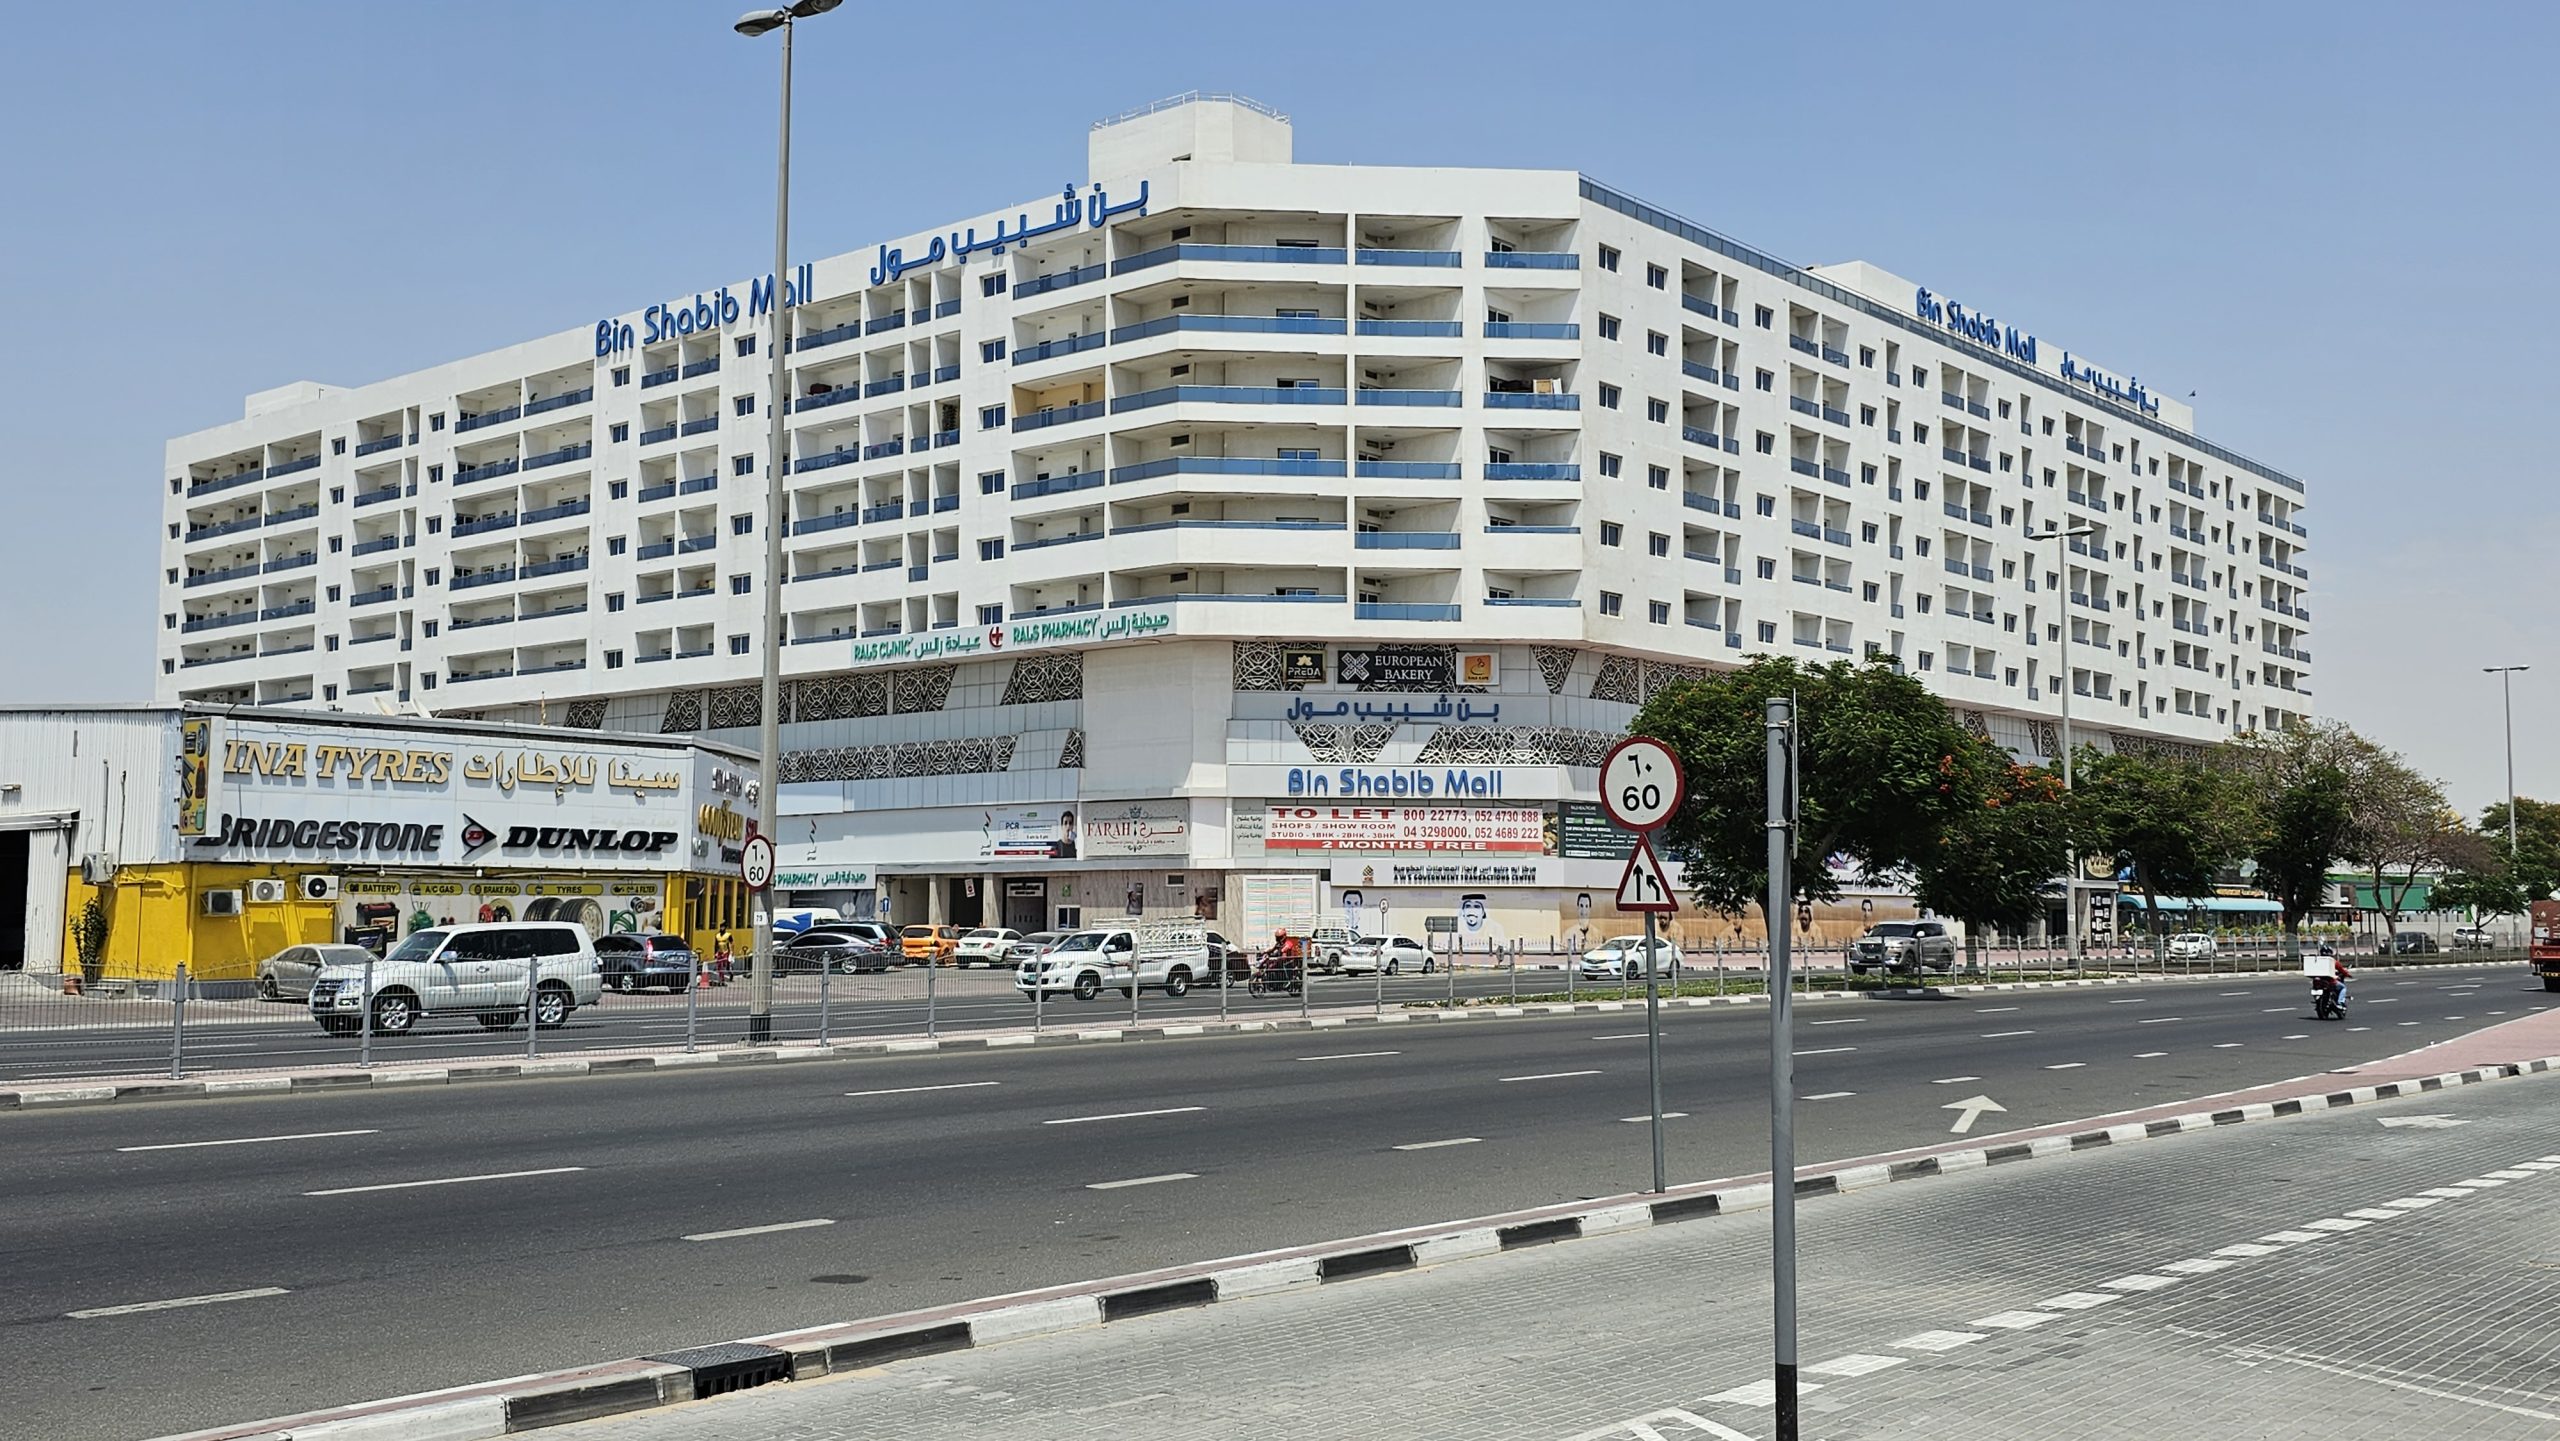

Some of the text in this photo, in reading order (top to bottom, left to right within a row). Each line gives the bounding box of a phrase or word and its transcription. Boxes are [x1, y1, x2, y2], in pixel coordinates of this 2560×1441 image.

[870, 180, 1149, 286] بن شبيب مول
[595, 263, 813, 357] Bin Shabib Mall
[1916, 286, 2037, 364] Bin Shabib Mall
[2061, 351, 2092, 380] مول
[1013, 618, 1098, 644] RALS PHARMACY
[854, 639, 912, 662] RALS CLINIC
[1375, 655, 1443, 667] EUROPEAN
[1287, 666, 1321, 676] PREDA
[1384, 669, 1434, 680] BAKERY
[1287, 694, 1500, 722] بن شبيب مول
[223, 740, 453, 784] INA TYRES
[1627, 754, 1653, 778] ٦٠
[463, 751, 598, 798] للإطارات
[608, 757, 682, 798] سينا
[1445, 768, 1502, 794] Mall
[1622, 784, 1661, 811] 60
[1271, 807, 1318, 820] TO
[1331, 808, 1396, 820] LET
[1403, 809, 1426, 821] 800
[1474, 811, 1493, 822] 052
[1495, 811, 1518, 822] 4730
[1521, 811, 1539, 822] 888
[193, 813, 444, 852] BRIDGESTONE
[1005, 822, 1020, 830] PCR
[1087, 821, 1131, 840] FARAH
[1271, 822, 1312, 830] SHOPS
[1403, 826, 1418, 838] 04
[1474, 827, 1493, 838] 052
[1495, 827, 1518, 838] 4689
[1521, 828, 1539, 839] 222
[502, 826, 678, 852] DUNLOP
[1338, 841, 1427, 849] MONTHS
[1433, 842, 1487, 850] FREE
[749, 866, 765, 882] 60
[776, 872, 819, 886] PHARMACY
[362, 884, 397, 893] BATTERY
[439, 885, 455, 893] GAS
[483, 886, 518, 894] BRAKE PAD
[556, 886, 583, 894] TYRES
